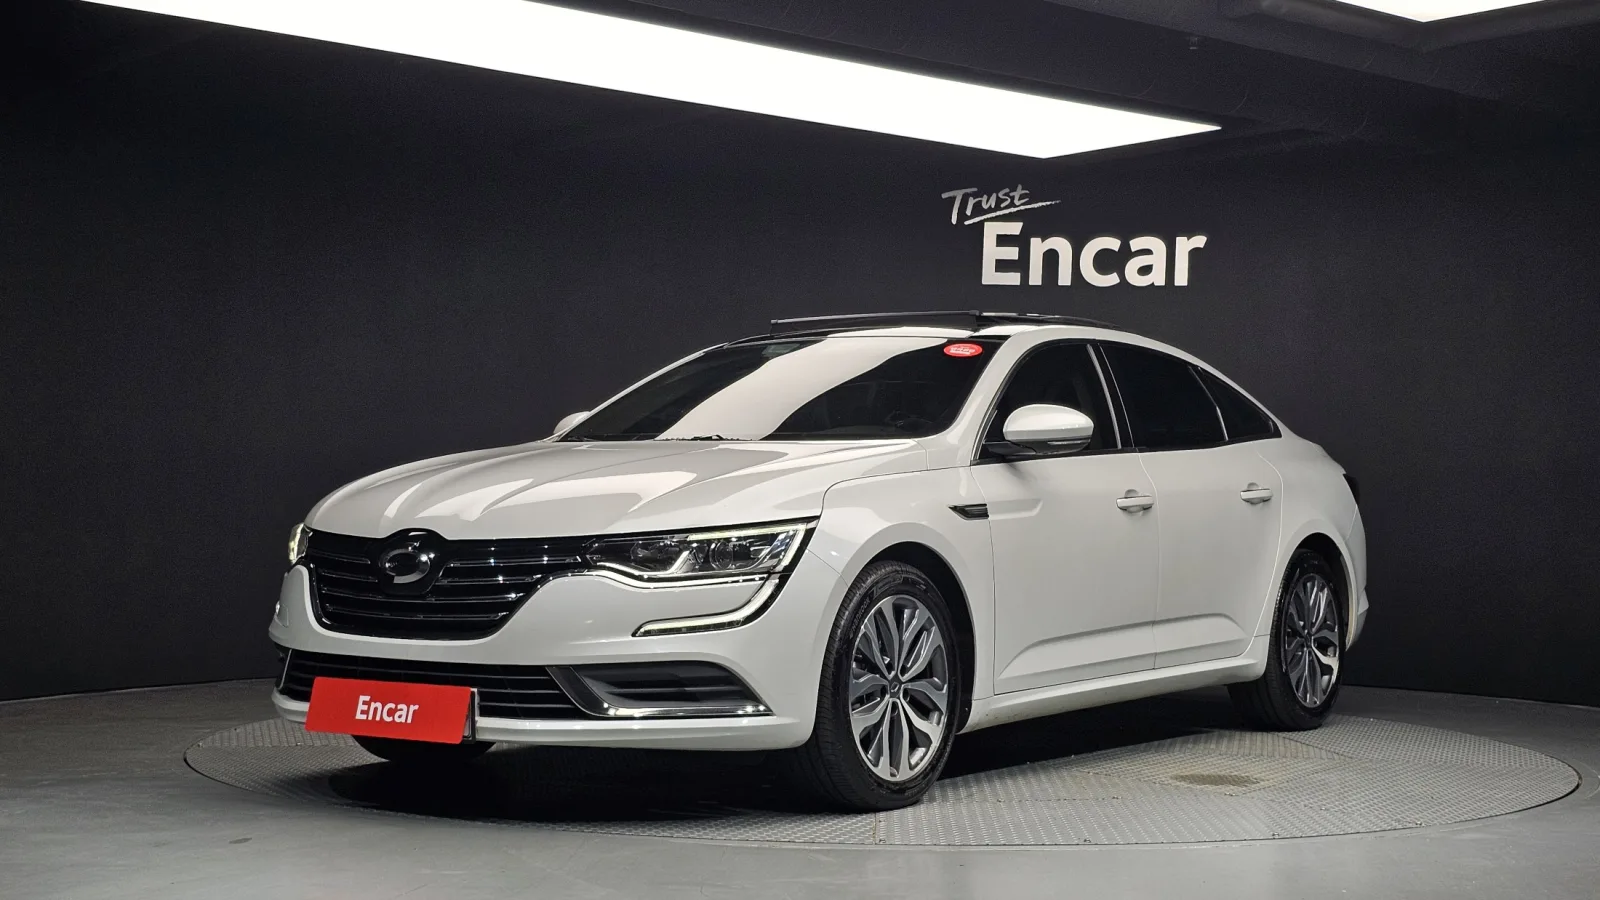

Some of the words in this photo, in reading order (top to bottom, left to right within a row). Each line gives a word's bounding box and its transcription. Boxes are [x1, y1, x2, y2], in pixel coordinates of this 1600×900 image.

[941, 184, 1031, 225] Trust
[981, 221, 1208, 287] Encar
[355, 695, 419, 723] Encar
